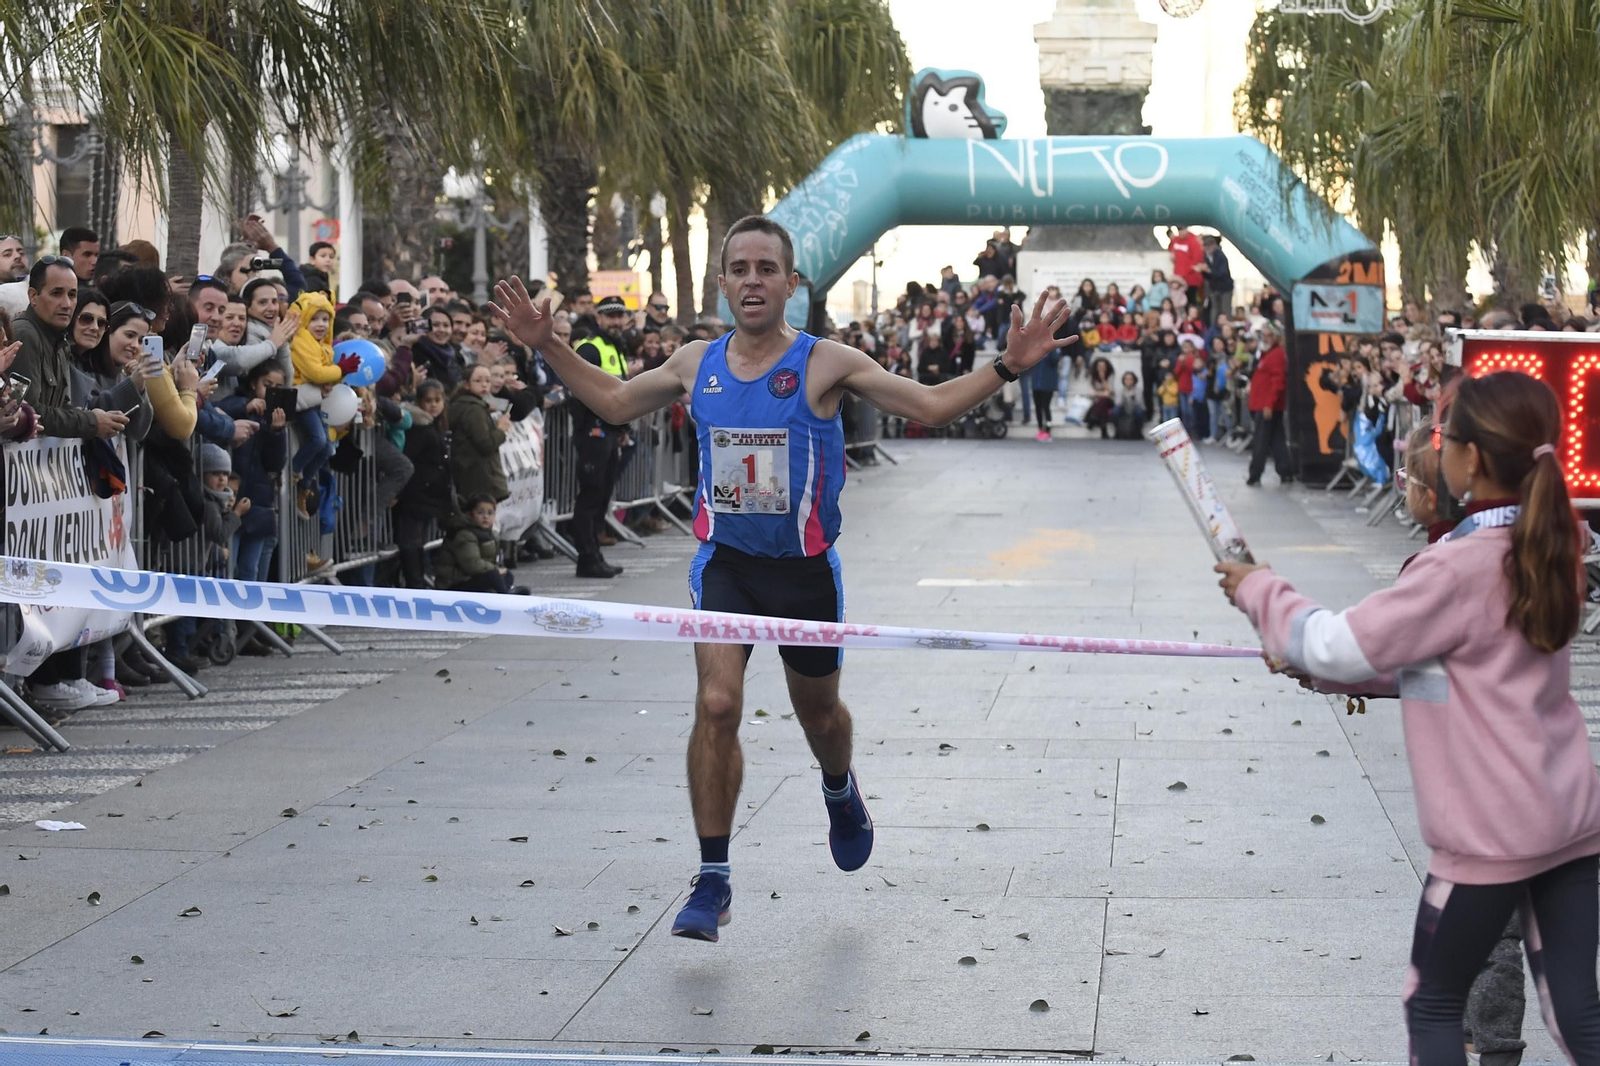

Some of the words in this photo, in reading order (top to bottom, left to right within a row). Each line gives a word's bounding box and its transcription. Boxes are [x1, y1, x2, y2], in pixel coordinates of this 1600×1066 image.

[967, 203, 1172, 221] PUBLICIDAD
[7, 450, 50, 507] DONA
[47, 445, 95, 501] SANGR
[741, 454, 756, 483] 1
[7, 517, 48, 561] DONA
[53, 508, 109, 563] MEDULA
